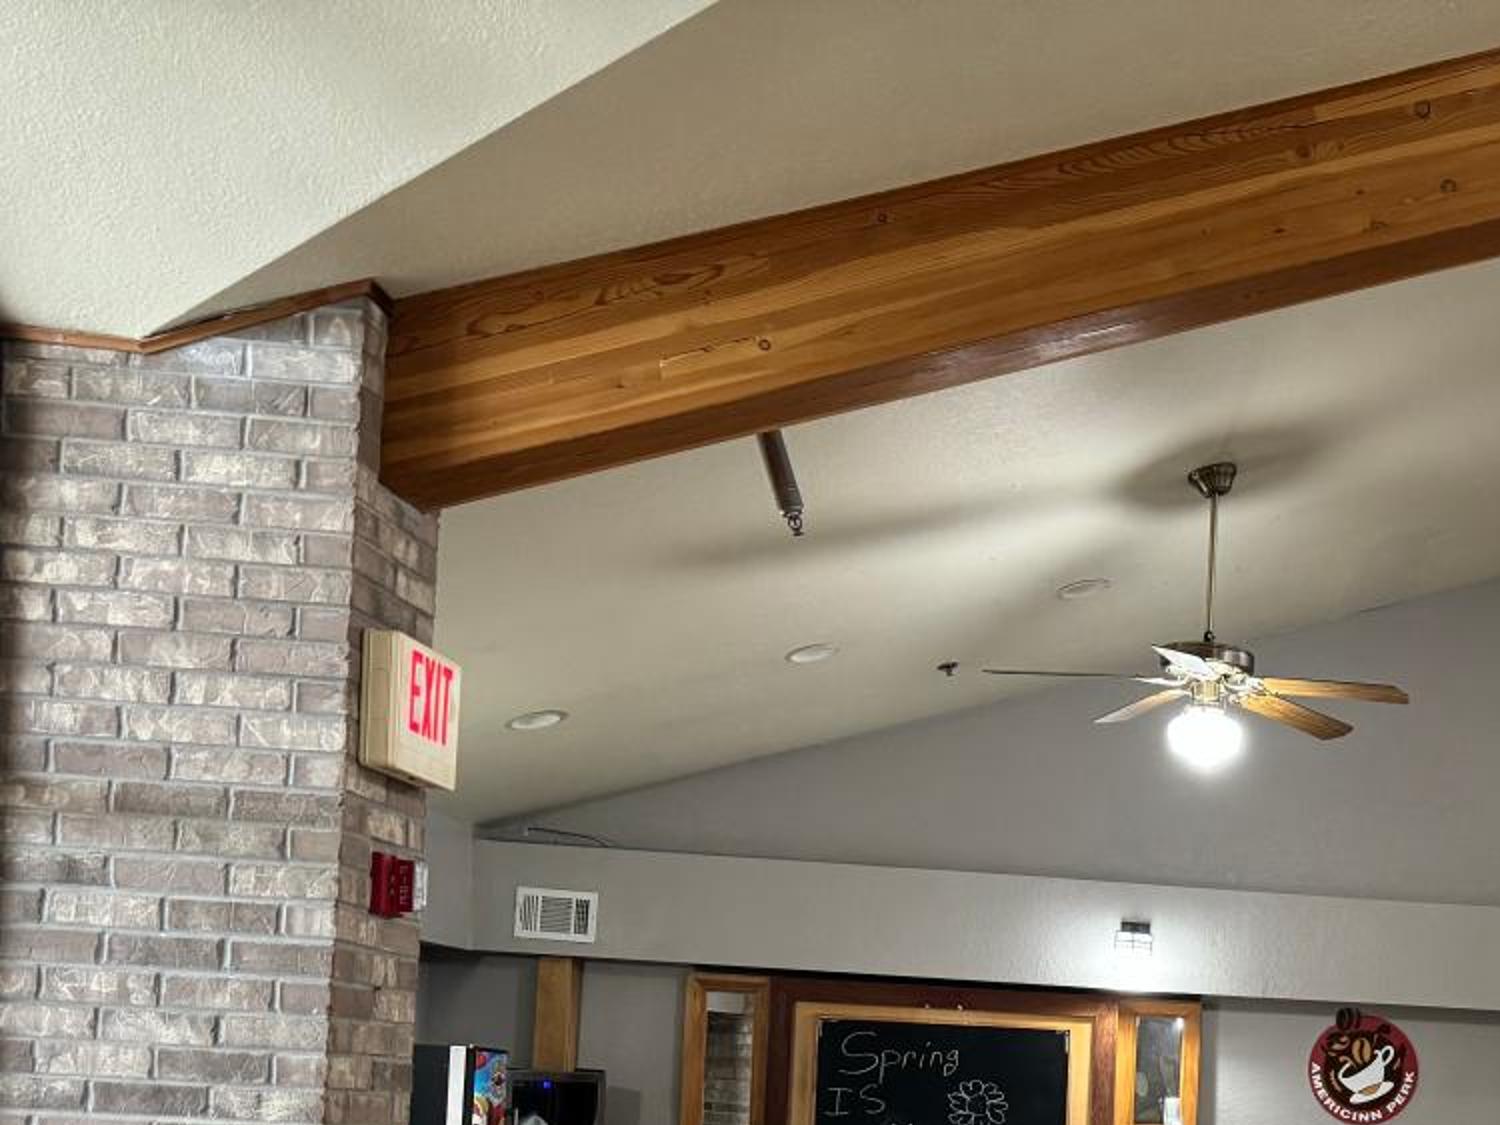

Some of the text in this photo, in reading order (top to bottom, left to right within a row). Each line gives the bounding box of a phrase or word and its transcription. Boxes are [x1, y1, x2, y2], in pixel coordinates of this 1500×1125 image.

[409, 649, 454, 746] EXIT
[838, 1031, 959, 1084] Spring
[1311, 1061, 1415, 1121] AMERICINN PERK
